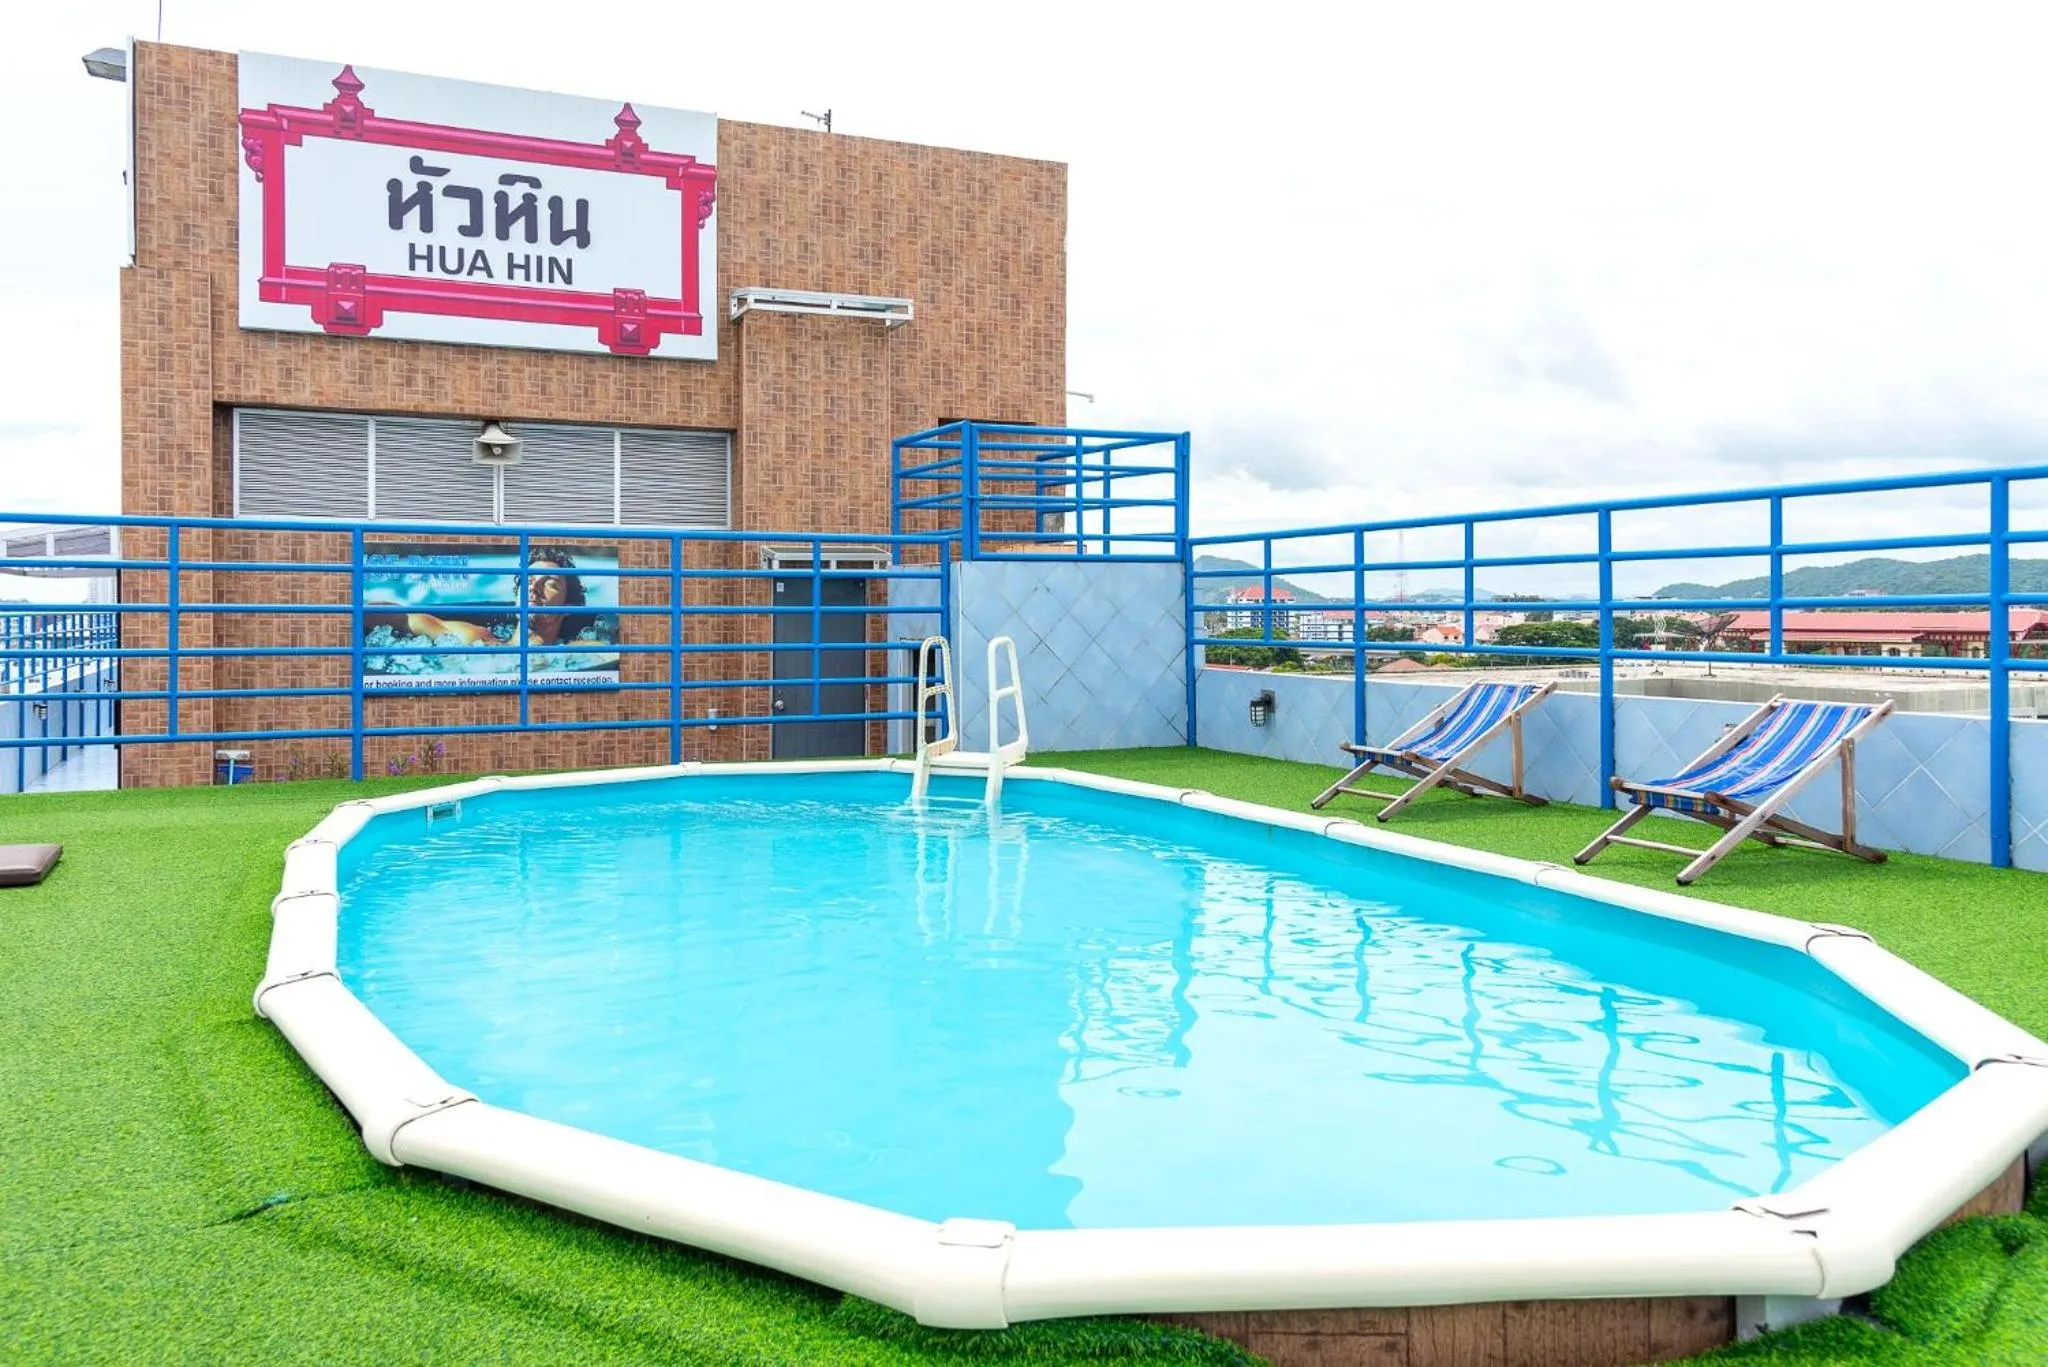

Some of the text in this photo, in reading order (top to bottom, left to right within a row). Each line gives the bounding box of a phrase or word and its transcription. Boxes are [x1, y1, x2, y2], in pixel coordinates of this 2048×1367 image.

[386, 155, 591, 249] หัวหิน
[408, 242, 573, 285] HUA HIN
[376, 679, 413, 689] booking
[416, 678, 432, 688] and
[434, 678, 457, 688] more
[459, 677, 509, 688] information
[540, 675, 571, 686] contact
